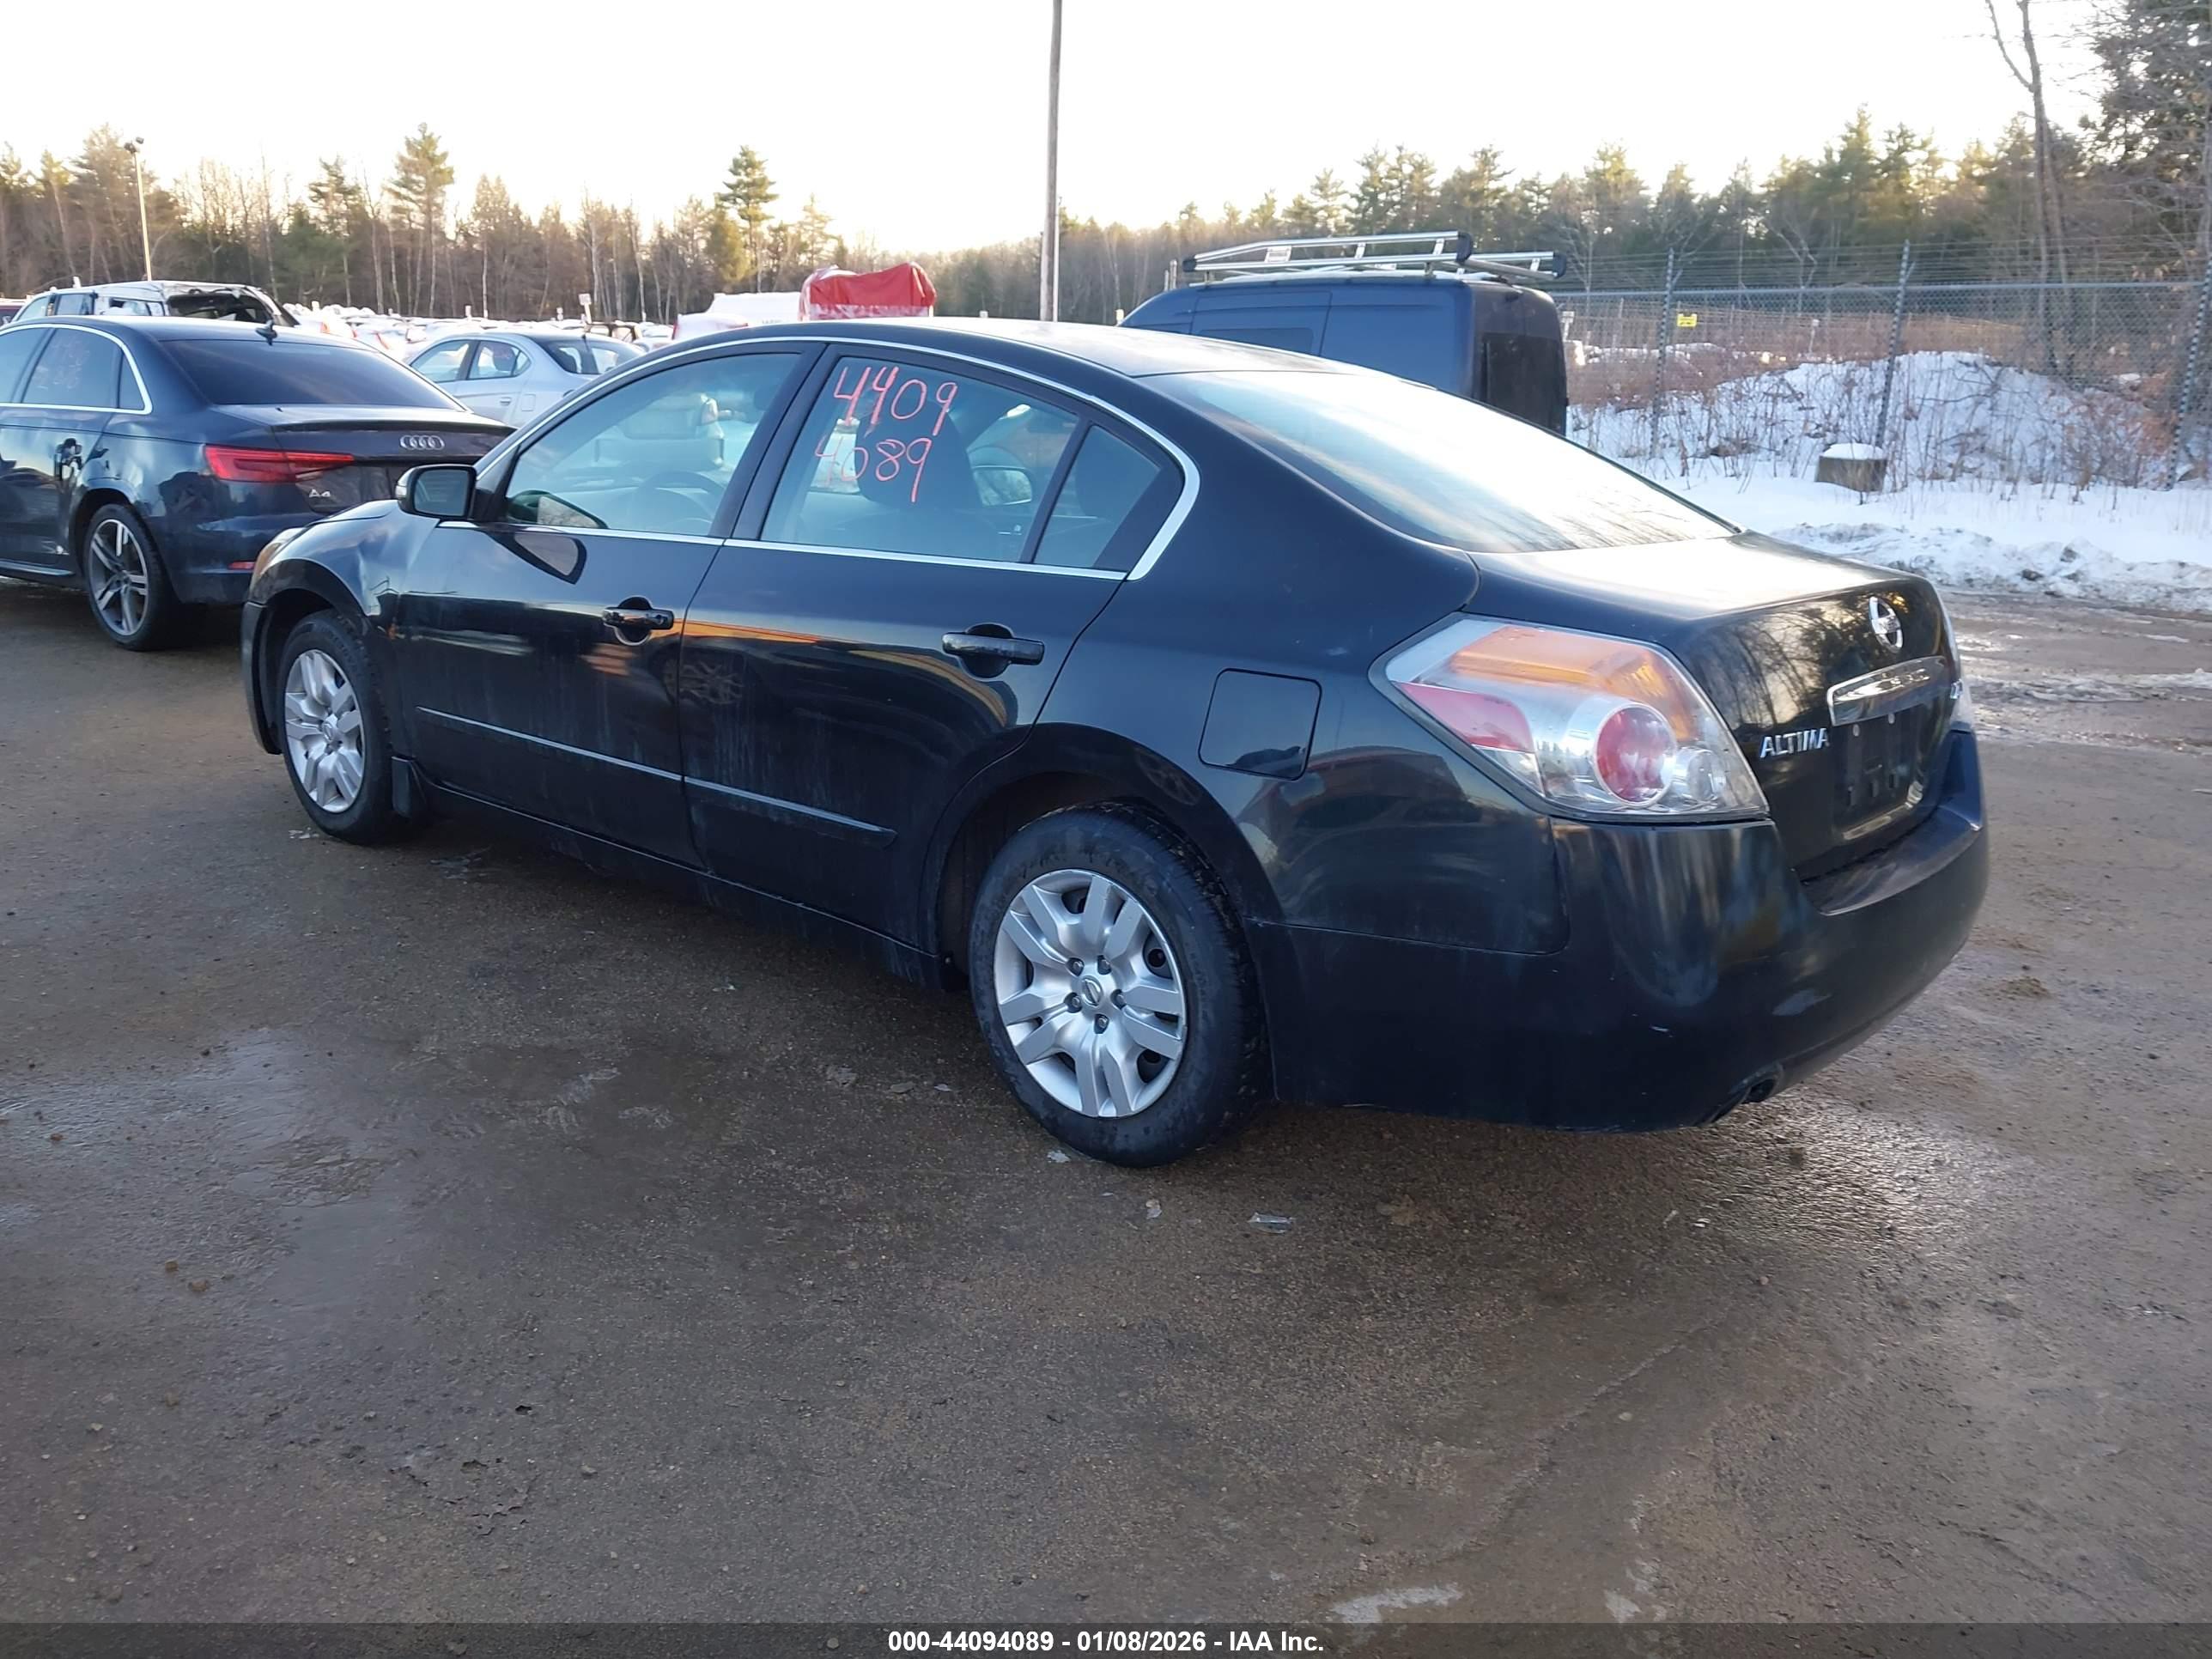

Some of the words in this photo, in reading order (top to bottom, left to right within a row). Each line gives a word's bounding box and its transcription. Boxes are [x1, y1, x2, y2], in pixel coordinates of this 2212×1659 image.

[834, 366, 957, 435] 4409
[815, 435, 933, 502] 4089
[309, 489, 331, 498] A4
[1759, 727, 1830, 758] ALTIMA
